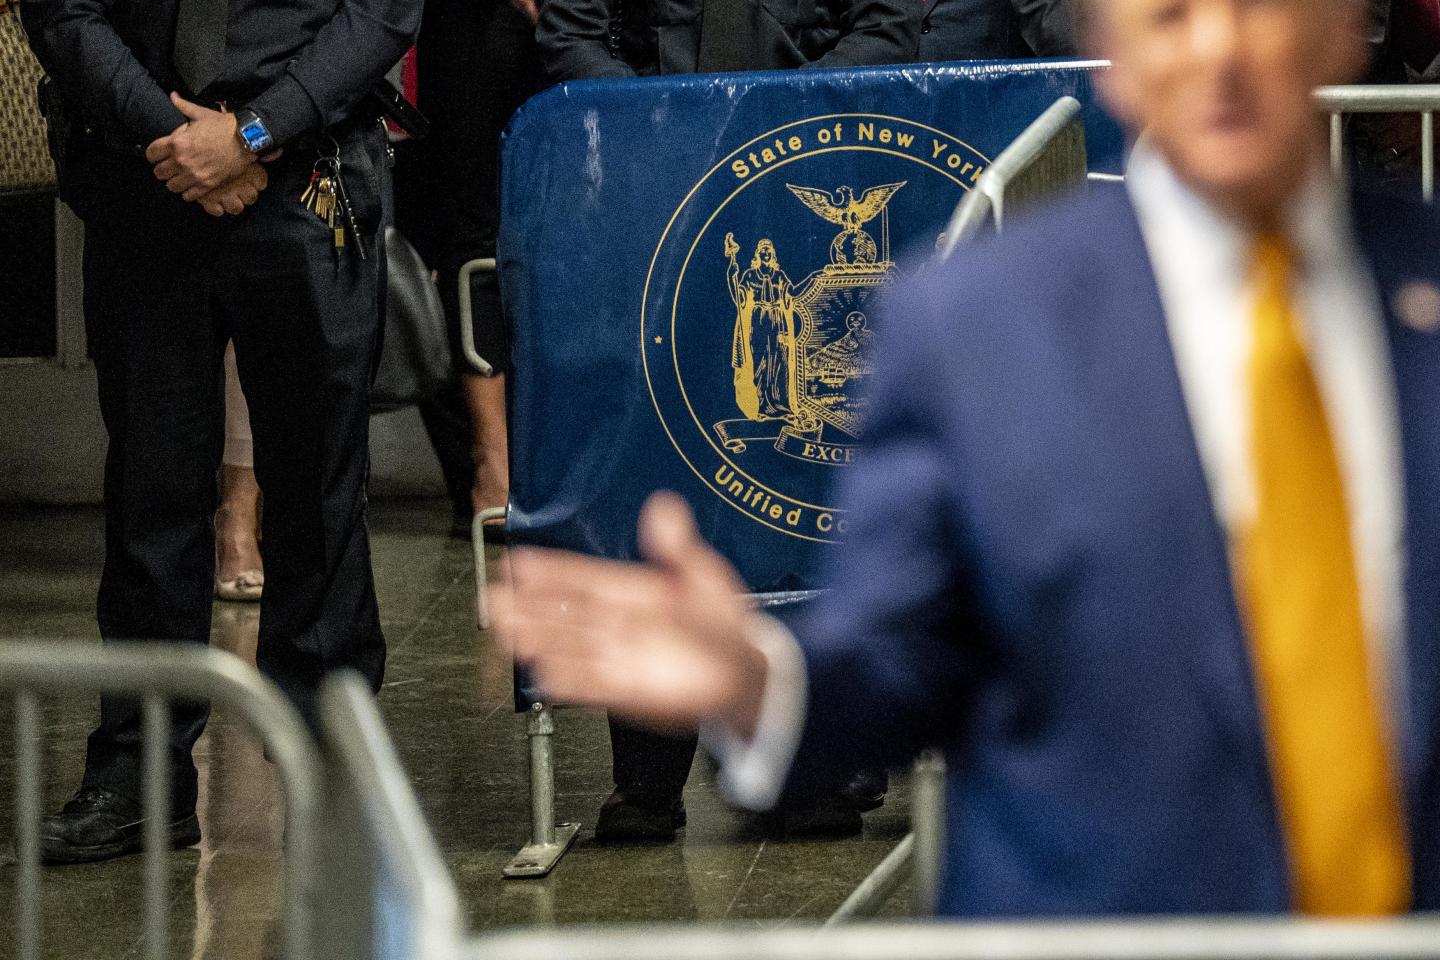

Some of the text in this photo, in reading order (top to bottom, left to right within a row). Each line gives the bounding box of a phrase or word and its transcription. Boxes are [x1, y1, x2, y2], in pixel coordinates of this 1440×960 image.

[731, 136, 802, 178] State
[817, 122, 843, 144] of
[858, 122, 915, 148] New
[715, 464, 802, 526] Unified
